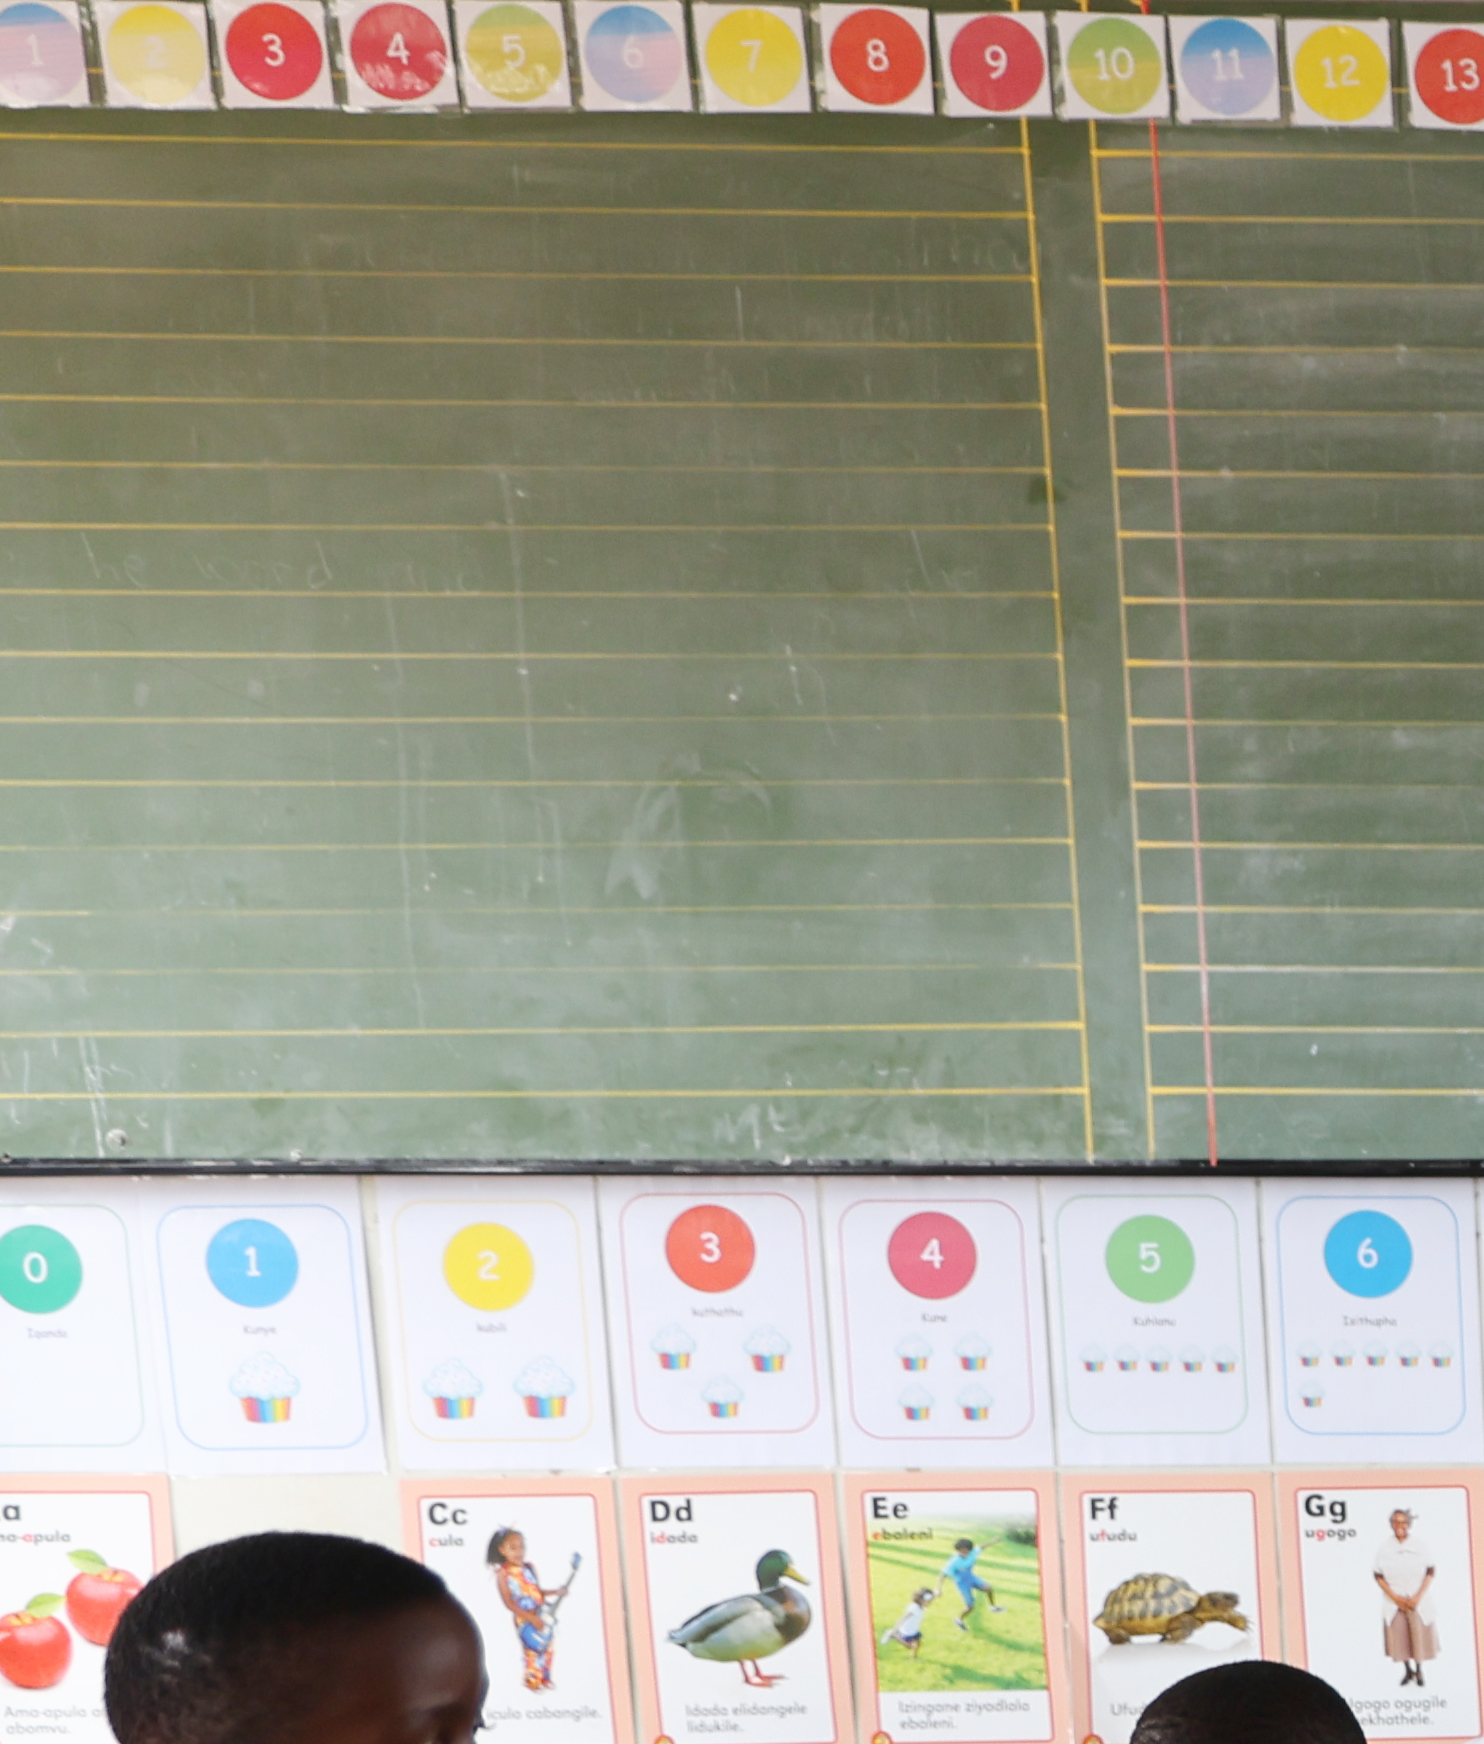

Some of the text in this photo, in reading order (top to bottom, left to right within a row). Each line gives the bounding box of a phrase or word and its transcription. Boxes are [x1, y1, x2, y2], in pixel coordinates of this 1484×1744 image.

[262, 33, 286, 66] 3
[386, 32, 410, 66] 4
[501, 34, 525, 68] 5
[622, 36, 644, 69] 6
[740, 39, 763, 72] 7
[866, 38, 890, 72] 8
[984, 45, 1007, 79] 9
[1094, 46, 1134, 81] 10
[1211, 48, 1245, 81] 11
[1321, 55, 1360, 88] 12
[1441, 58, 1480, 92] 13
[243, 1247, 260, 1277] 1
[700, 1232, 721, 1263] 3
[921, 1238, 945, 1269] 4
[1138, 1242, 1162, 1273] 5
[1356, 1238, 1380, 1268] 6
[23, 1252, 48, 1283] 0
[478, 1251, 500, 1282] 2
[428, 1502, 468, 1527] Cc
[650, 1499, 693, 1523] Dd
[872, 1498, 909, 1520] Ee
[1090, 1499, 1118, 1520] Ff
[1304, 1494, 1348, 1524] Gg
[428, 1534, 464, 1547] cula
[872, 1528, 933, 1541] ebaleni
[1090, 1530, 1137, 1542] ufudu
[1304, 1528, 1357, 1541] ugogo
